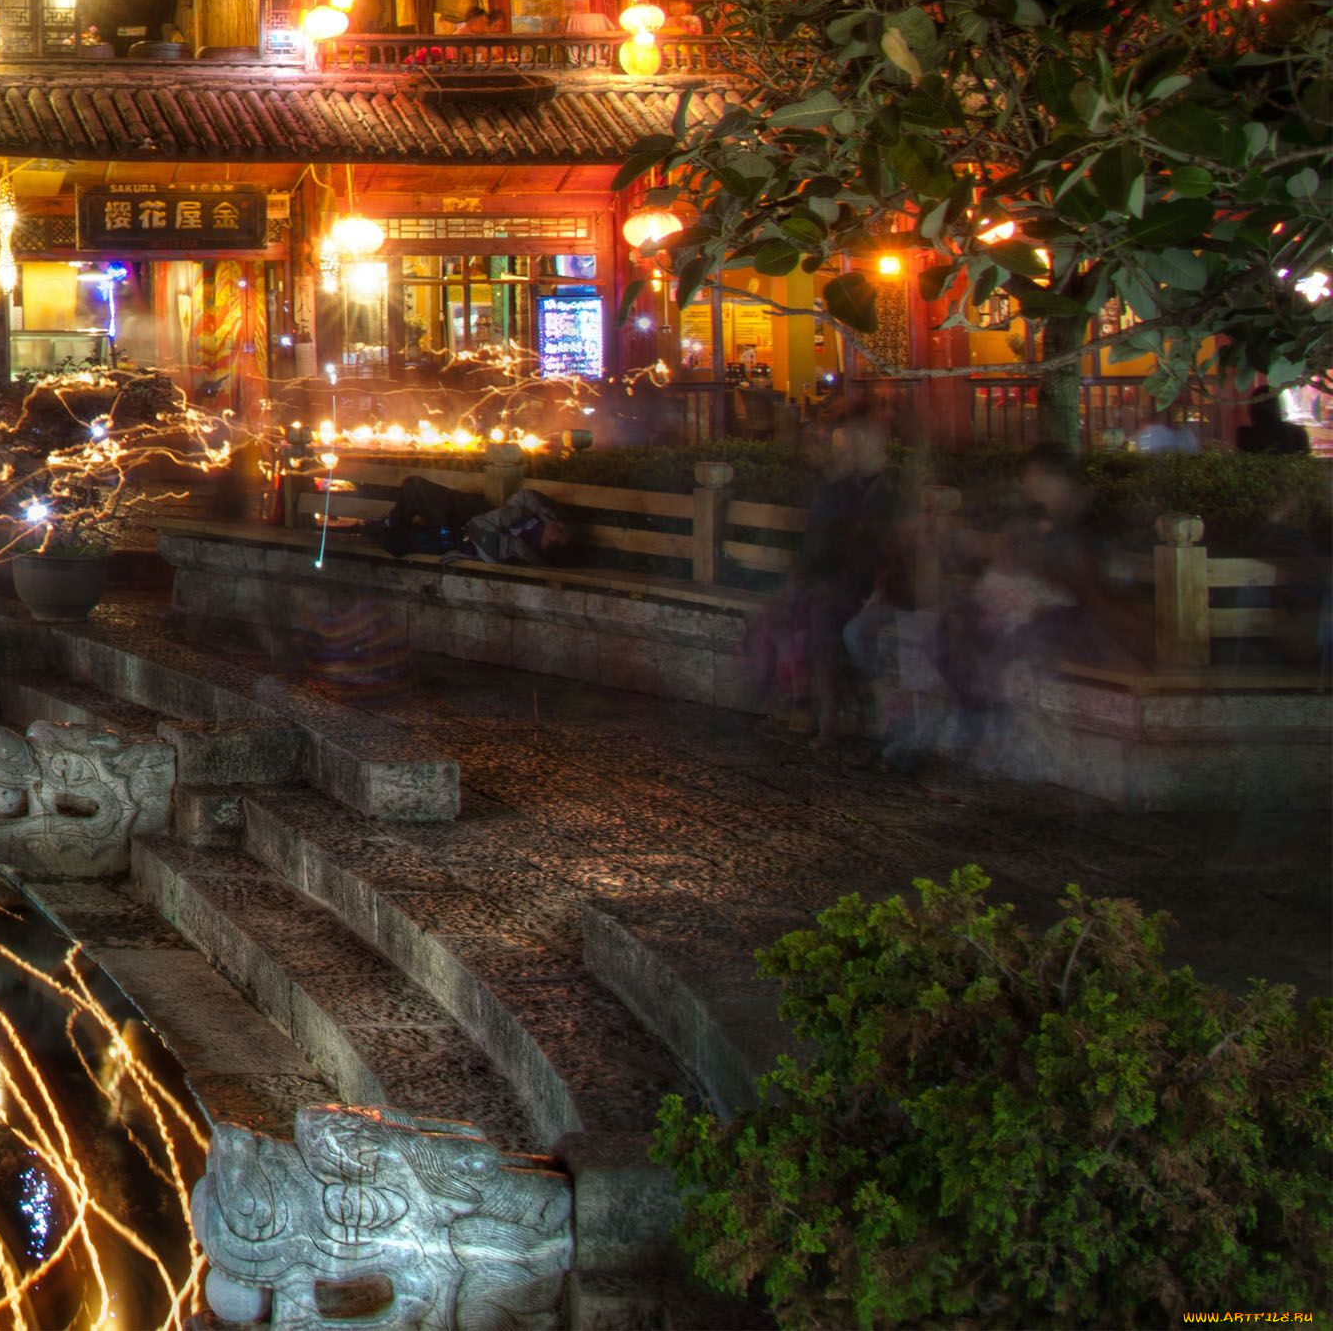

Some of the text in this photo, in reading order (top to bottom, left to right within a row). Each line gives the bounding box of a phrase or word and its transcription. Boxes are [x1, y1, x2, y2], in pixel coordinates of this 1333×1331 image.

[109, 184, 157, 194] SAKURA
[104, 200, 240, 230] 樱花屋金
